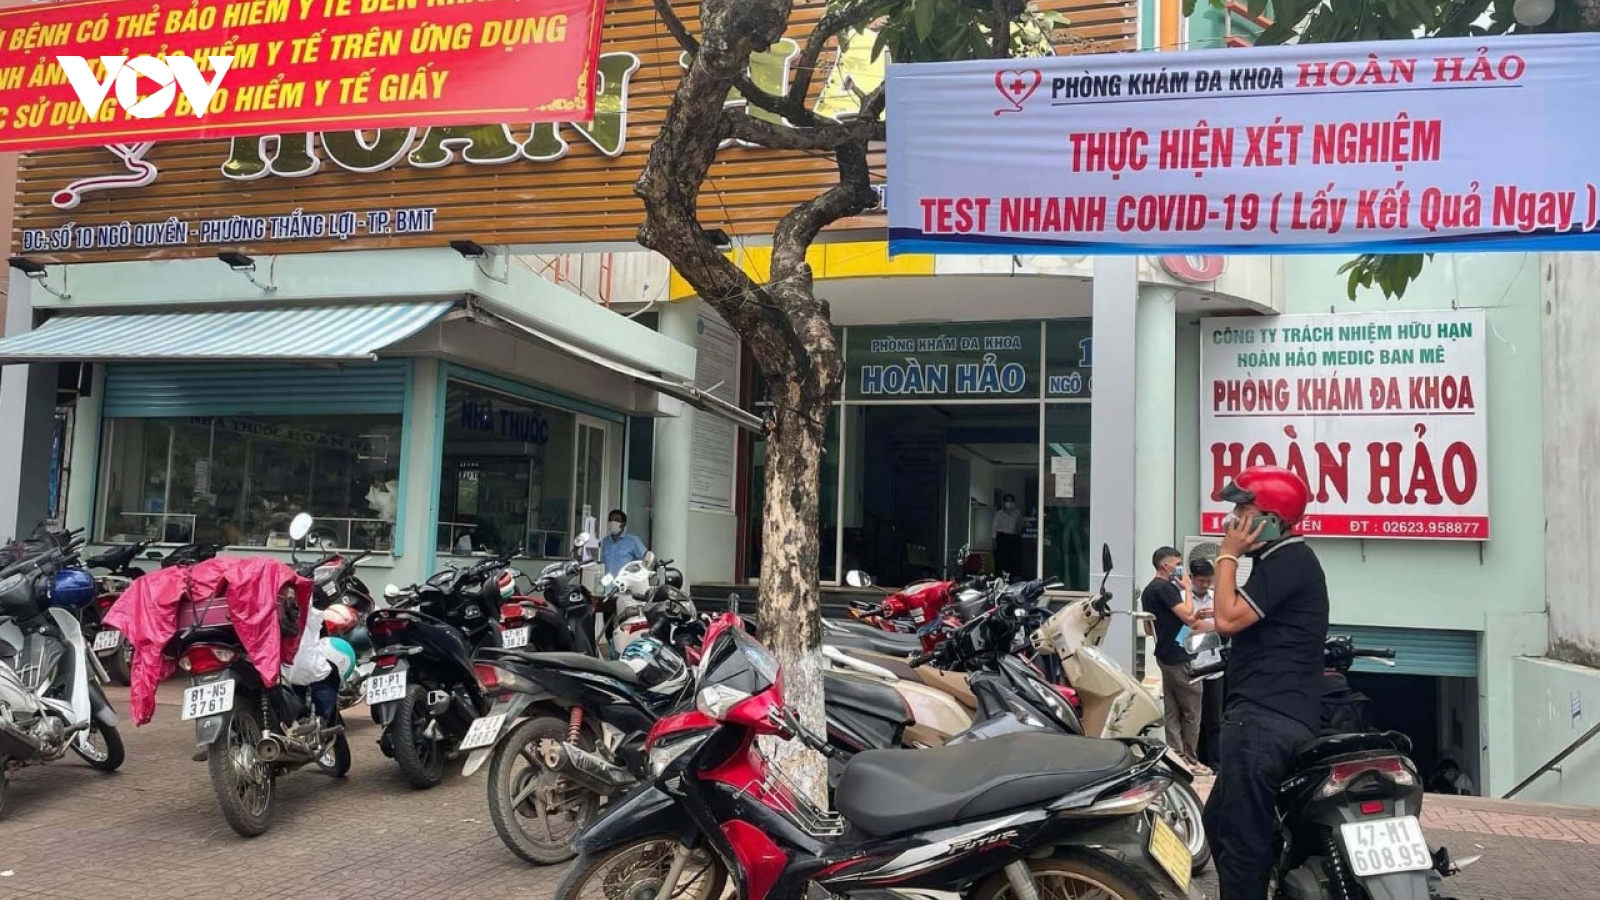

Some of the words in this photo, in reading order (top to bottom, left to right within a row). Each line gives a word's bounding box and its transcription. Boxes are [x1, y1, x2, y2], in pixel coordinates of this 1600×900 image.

[8, 21, 73, 54] BỆNH
[76, 13, 110, 43] CÓ
[115, 5, 160, 39] THẺ
[164, 0, 217, 34] BẢO
[267, 41, 284, 66] Y
[290, 28, 327, 63] TẾ
[330, 26, 403, 61] TRÊN
[409, 22, 474, 54] ỨNG
[480, 14, 568, 53] DỤNG
[1051, 71, 1122, 99] PHÒNG
[1128, 67, 1189, 95] KHÁM
[1194, 70, 1223, 93] ĐA
[1229, 66, 1284, 91] KHOA
[1296, 53, 1417, 88] HOÀN
[1432, 46, 1527, 83] HẢO
[13, 95, 51, 129] SỬ
[175, 82, 230, 117] BO
[234, 73, 306, 112] HIỂM
[314, 80, 331, 107] Y
[339, 67, 375, 105] TẾ
[379, 62, 449, 102] GIẤY
[1069, 127, 1149, 180] THỰC
[1159, 119, 1235, 178] HIỆN
[1243, 116, 1303, 168] XÉT
[1311, 112, 1442, 172] NGHIỆM
[51, 222, 76, 249] SỐ
[76, 227, 94, 248] 10
[98, 221, 131, 247] NGÔ
[134, 216, 188, 246] QUYỀN
[200, 215, 266, 243] PHƯỜNG
[270, 207, 325, 239] THẮNG
[329, 211, 355, 240] LỢI
[368, 210, 391, 234] TP.
[396, 208, 436, 232] BMT
[920, 197, 991, 234] TEST
[999, 195, 1107, 234] NHANH
[1115, 191, 1261, 232] COVID-19
[1291, 182, 1348, 234] Lấy
[1356, 181, 1411, 230] Kết
[1419, 181, 1482, 232] Quả
[1492, 185, 1577, 233] Ngay
[871, 335, 915, 352] PHÒNG
[919, 334, 956, 351] KHÁM
[960, 337, 980, 351] ĐA
[984, 336, 1021, 350] KHOA
[1213, 326, 1255, 344] CÔNG
[1260, 328, 1277, 343] TY
[1282, 324, 1333, 342] TRÁCH
[1339, 322, 1392, 344] NHIỆM
[1397, 321, 1431, 339] HỮU
[1437, 322, 1472, 342] HẠN
[861, 357, 948, 395] HOÀN
[955, 353, 1026, 394] HẢO
[1237, 349, 1280, 368] HOÀN
[1285, 346, 1317, 367] HẢO
[1322, 350, 1374, 366] MEDIC
[1379, 348, 1414, 365] BAN
[1419, 345, 1445, 364] MÊ
[1049, 371, 1082, 394] NGÔ
[1213, 371, 1290, 412] PHÒNG
[1297, 370, 1363, 411] KHÁM
[1370, 376, 1402, 410] ĐA
[1409, 374, 1475, 410] KHOA
[1367, 423, 1477, 505] HẢO
[1350, 521, 1369, 532] ĐT
[1382, 520, 1480, 534] 02623.958877
[190, 696, 224, 717] 3761
[1354, 844, 1427, 872] 608.95
